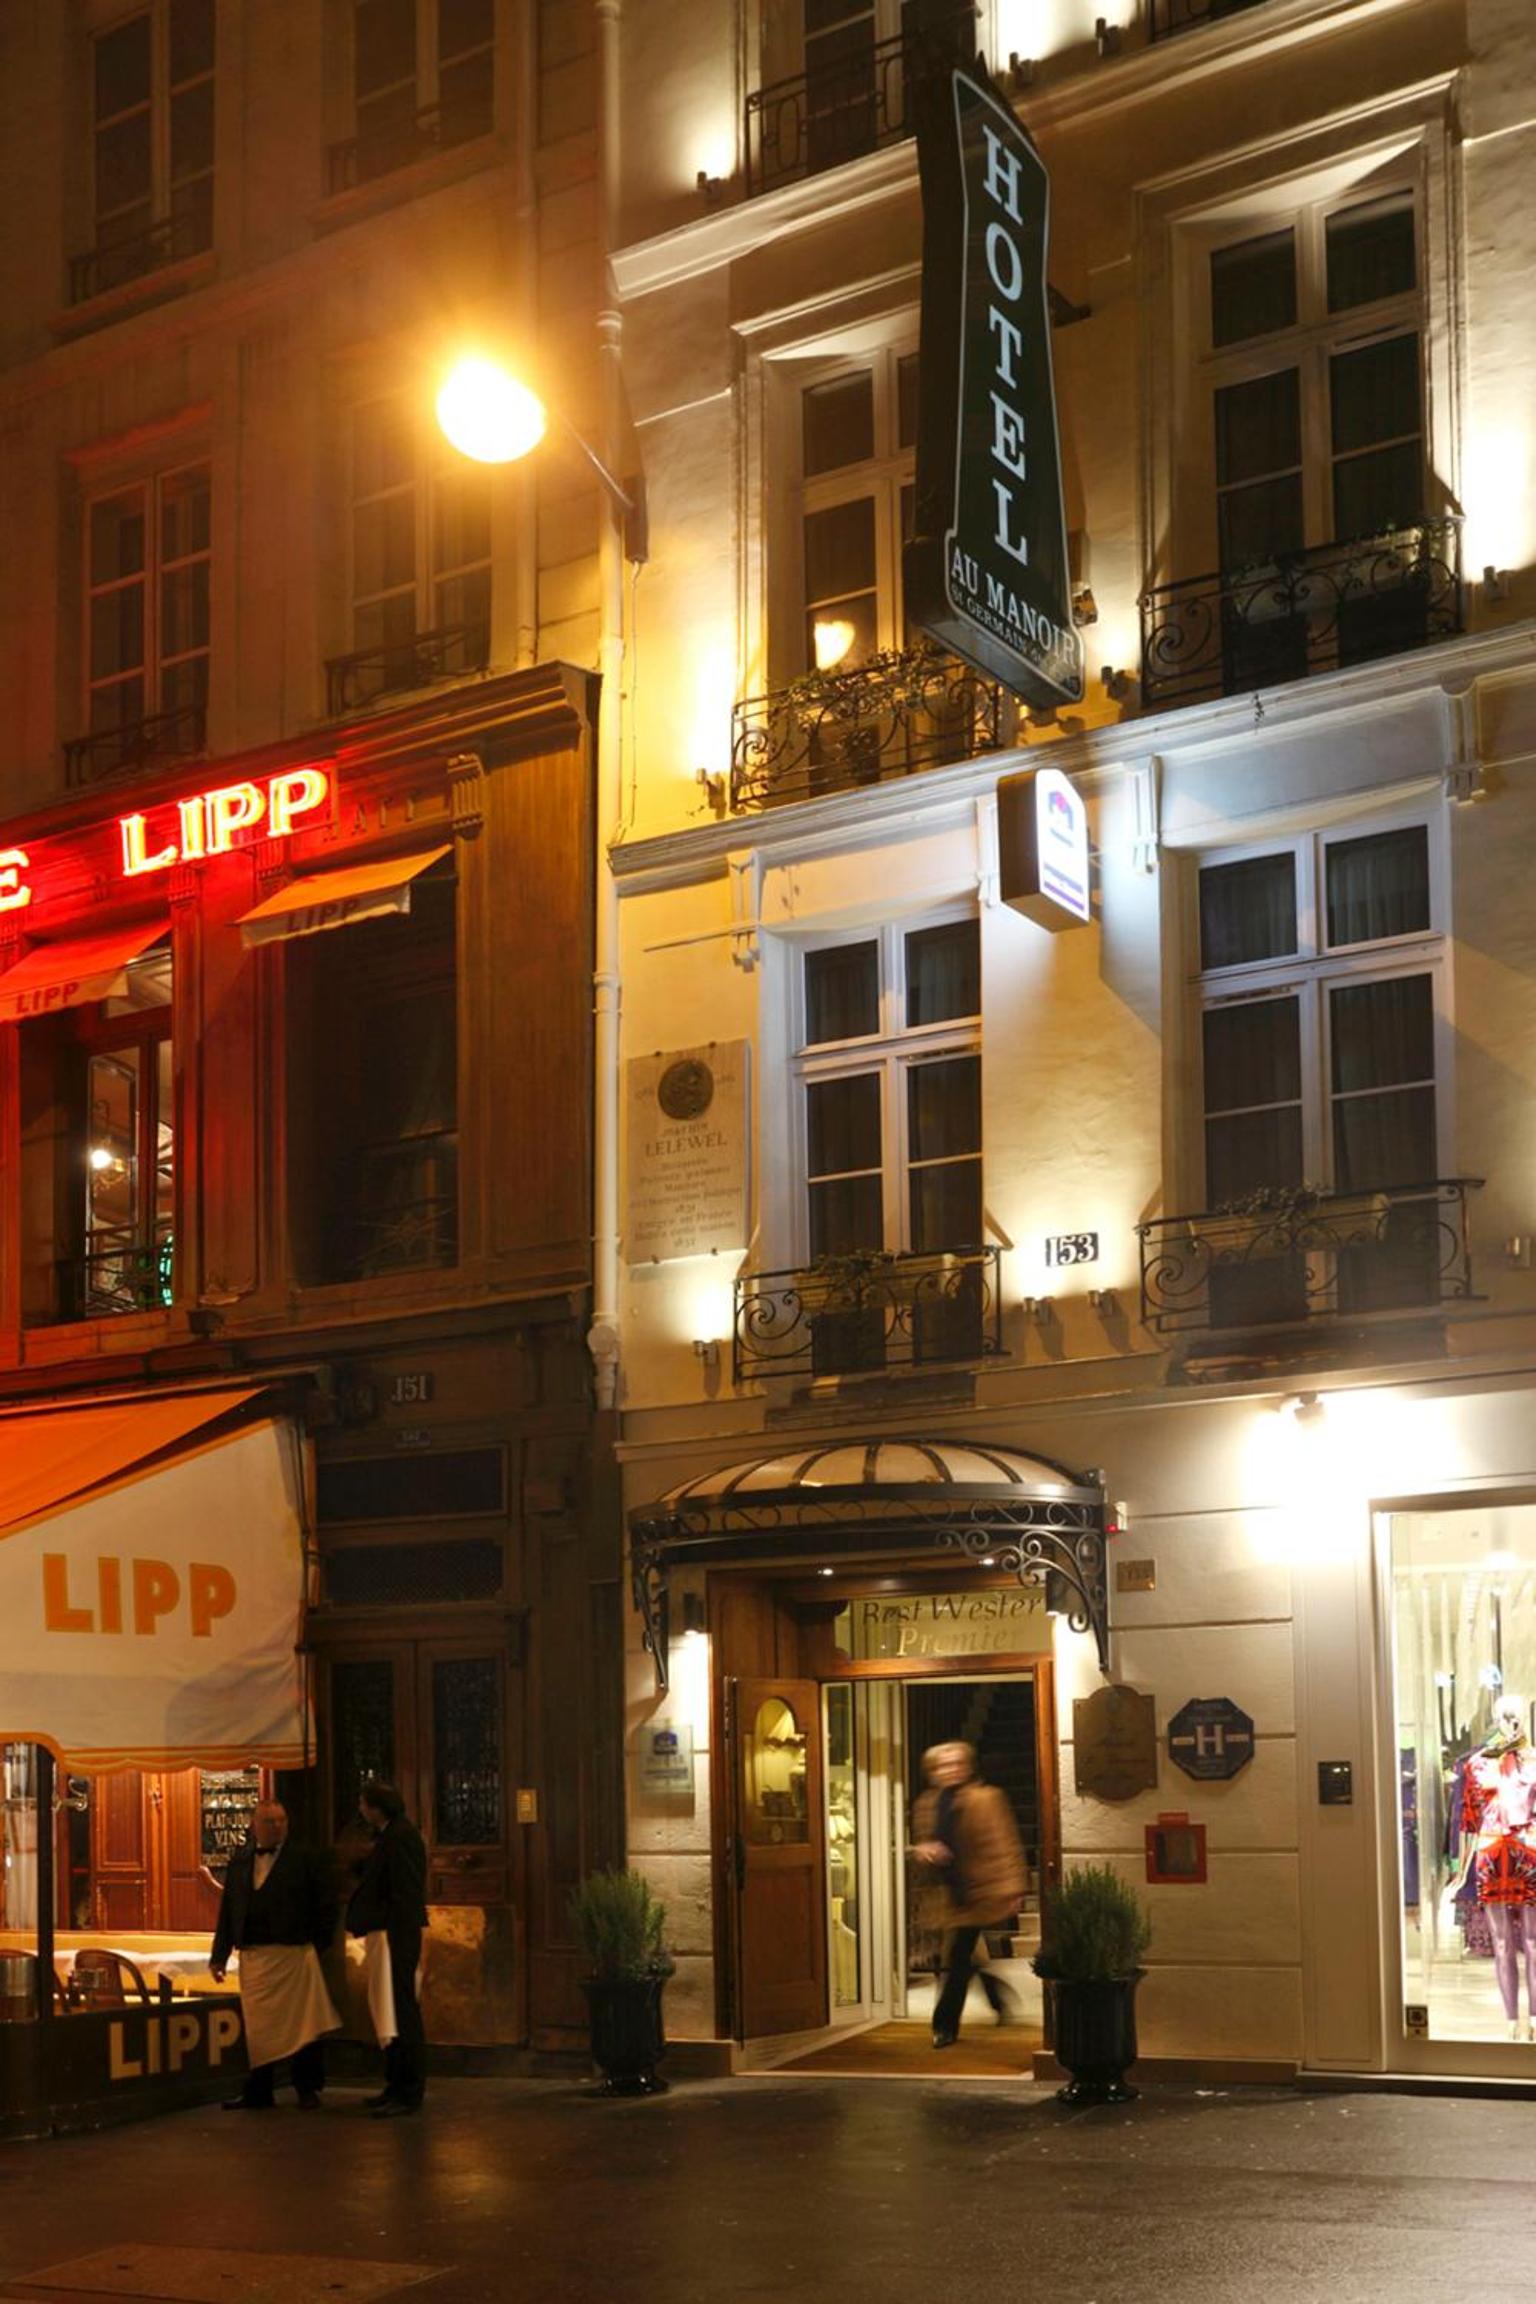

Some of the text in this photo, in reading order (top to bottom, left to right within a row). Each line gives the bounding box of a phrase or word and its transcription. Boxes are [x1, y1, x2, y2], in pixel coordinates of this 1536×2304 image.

[983, 124, 1028, 567] HOTEL
[951, 546, 1076, 669] AU MANOIR
[119, 769, 328, 877] LIPP
[286, 898, 358, 932] LIPP
[16, 982, 79, 1014] LIPP
[645, 1131, 728, 1157] LELEWEL
[1047, 1233, 1096, 1266] 153
[391, 1375, 427, 1402] 151
[42, 1553, 237, 1637] LIPP
[931, 1594, 1045, 1621] Wester
[108, 2009, 241, 2080] LIPP
